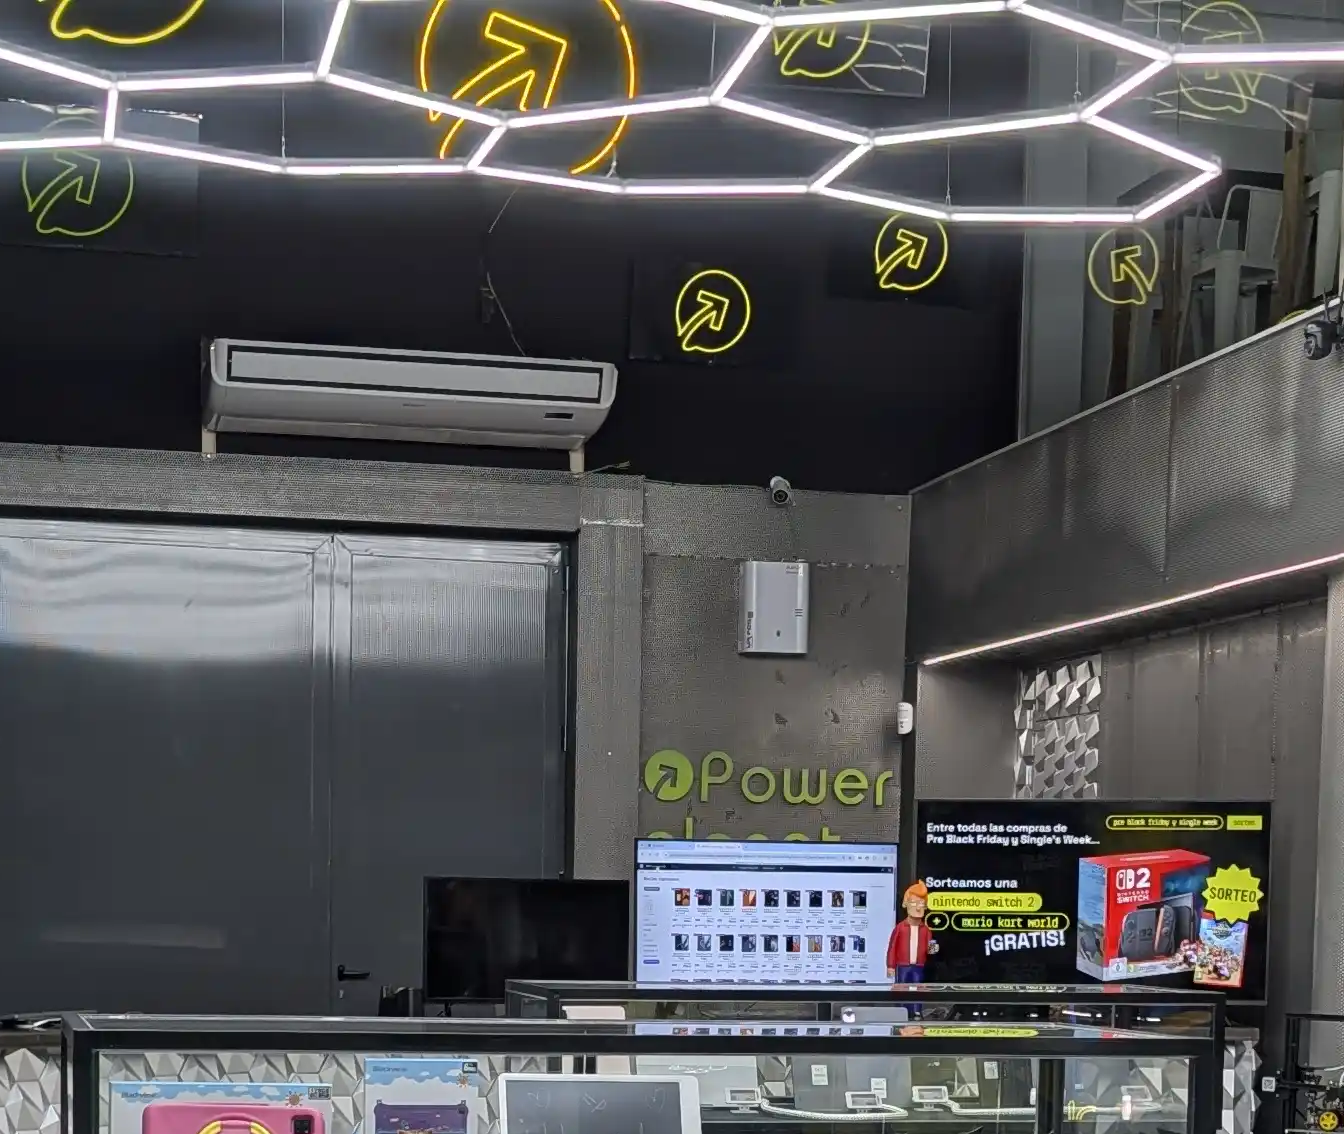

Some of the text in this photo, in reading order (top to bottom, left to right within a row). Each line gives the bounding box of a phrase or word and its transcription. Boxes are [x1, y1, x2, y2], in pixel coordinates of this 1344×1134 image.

[700, 751, 894, 806] Power
[926, 822, 1068, 835] Entre todas las compras de
[926, 834, 944, 844] Pre
[945, 834, 975, 845] Black
[976, 834, 1010, 847] Friday
[1011, 836, 1019, 847] y
[925, 876, 1018, 889] Sorteamos una
[1117, 894, 1150, 904] SWITCH
[1209, 886, 1257, 903] SORTEO
[932, 896, 1035, 908] nintendo switch 2
[961, 916, 1059, 929] mario kart world
[984, 930, 1066, 956] ¡GRATIS!
